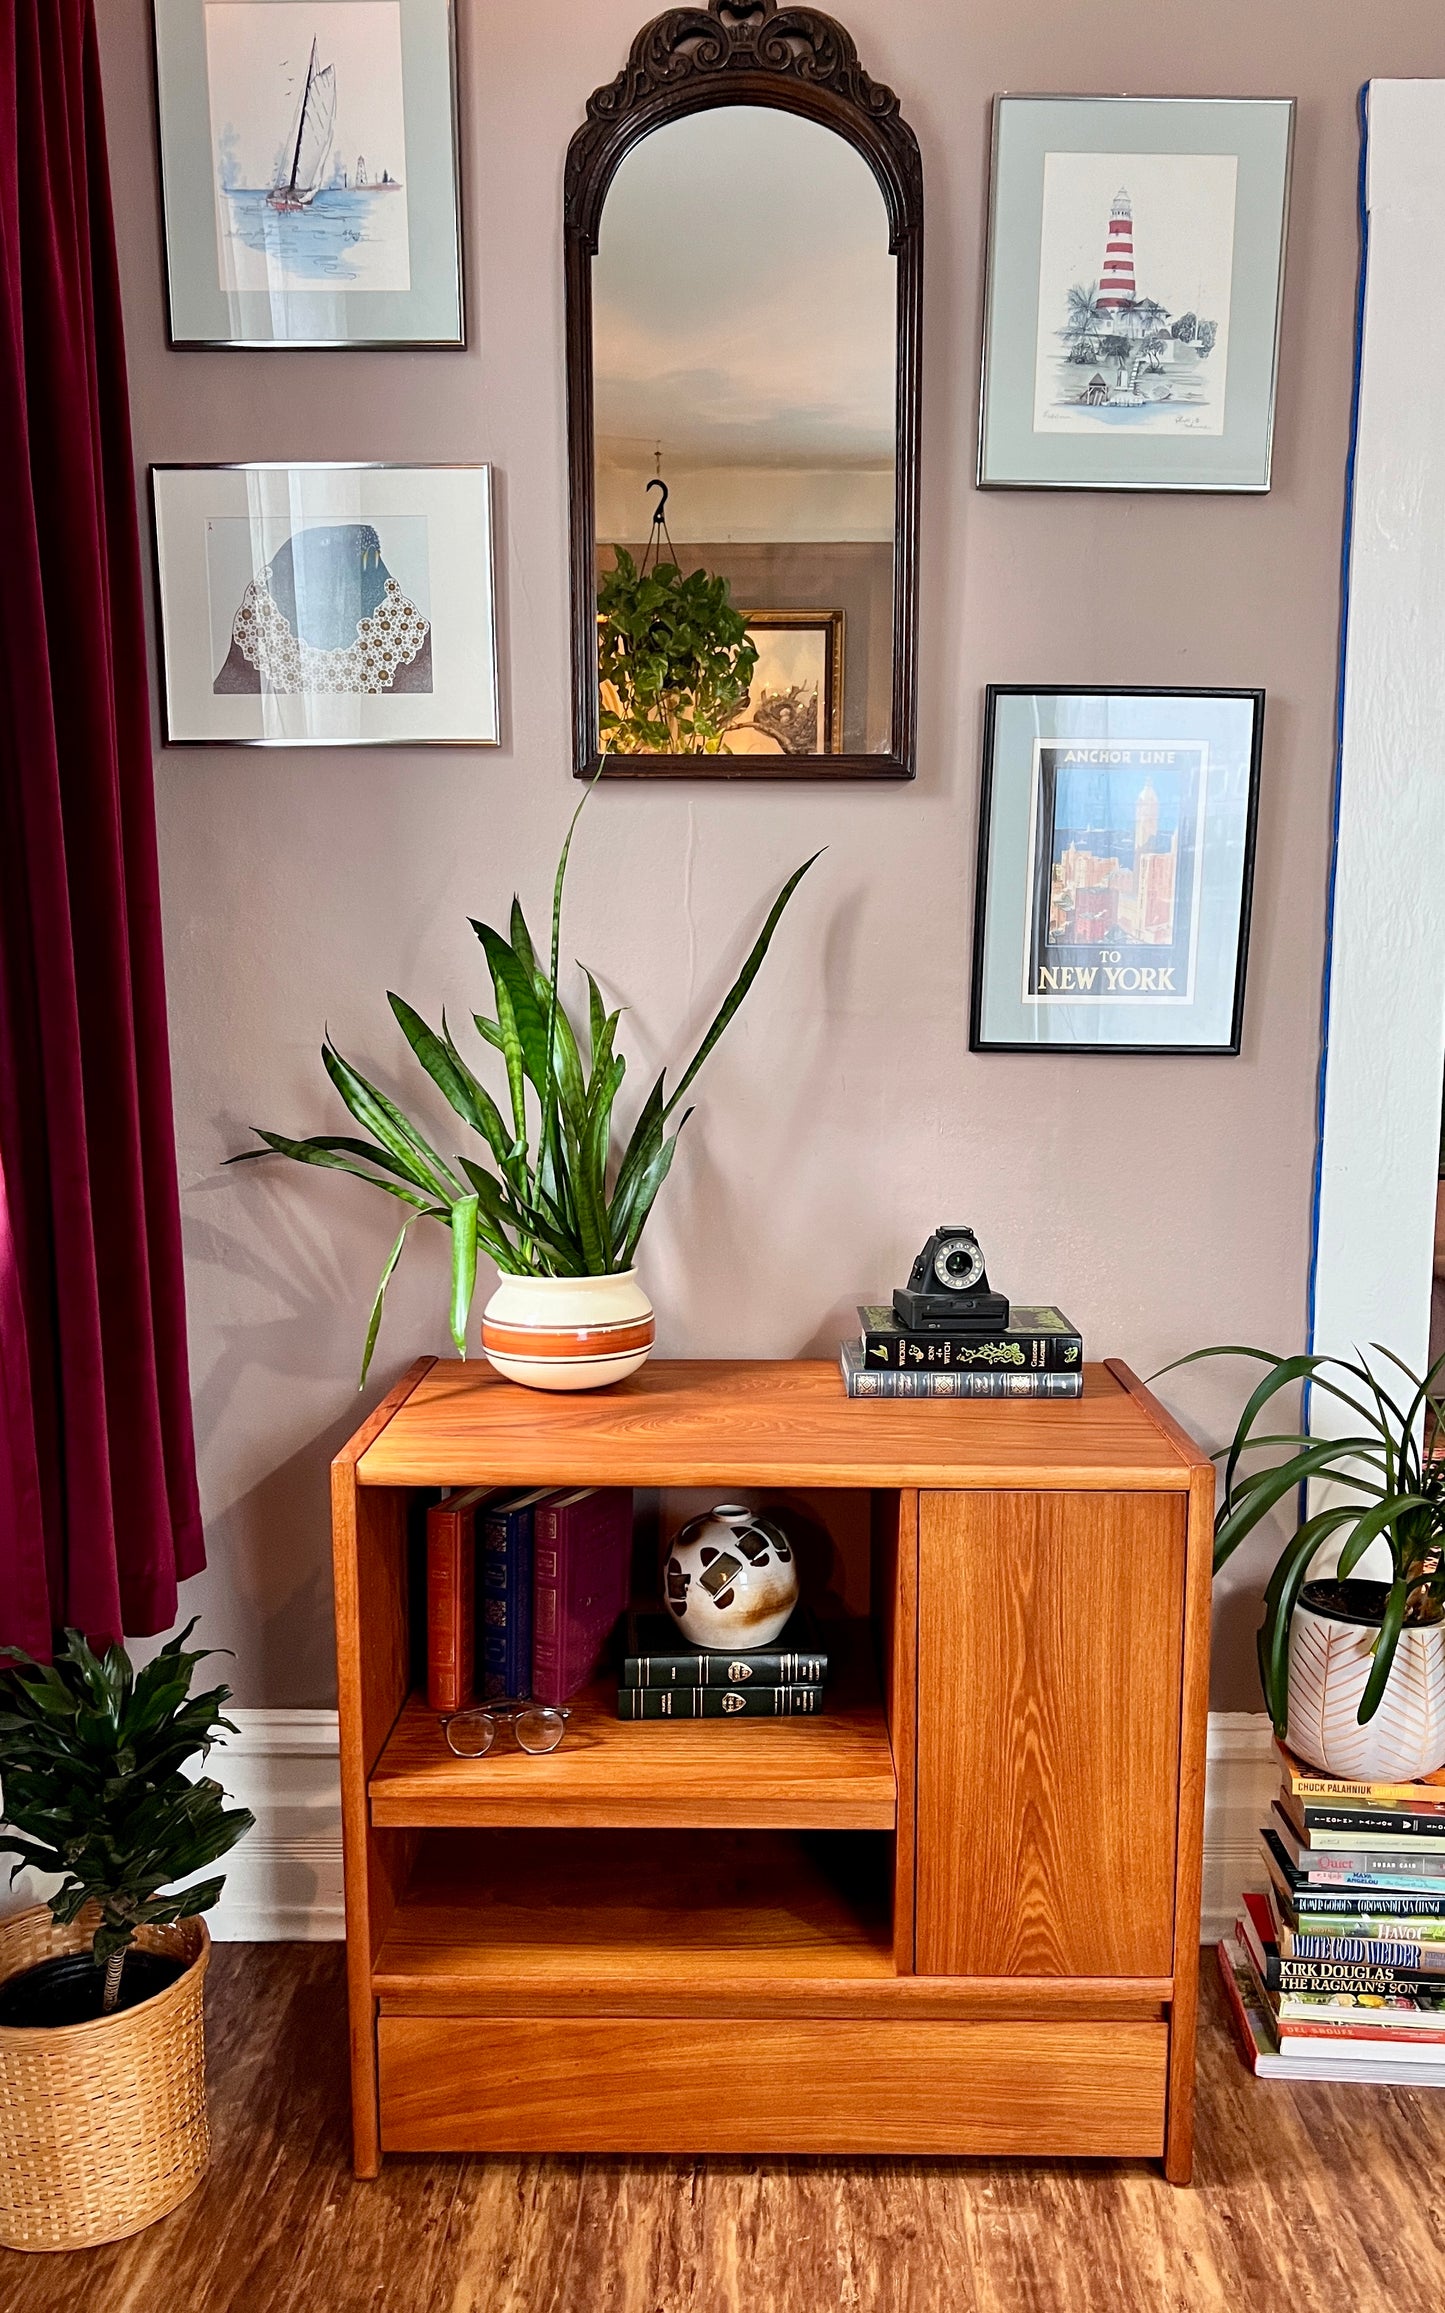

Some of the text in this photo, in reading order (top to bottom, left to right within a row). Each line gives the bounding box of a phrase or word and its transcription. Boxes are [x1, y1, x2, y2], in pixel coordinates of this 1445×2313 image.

[1064, 750, 1176, 764] ANCHOR LINE
[1099, 950, 1121, 962] TO
[1038, 966, 1176, 990] NEW YORK
[1298, 1782, 1325, 1793] CHUCK
[1327, 1783, 1372, 1794] PALAHNIUK
[1359, 1819, 1393, 1827] TAYLOR
[1317, 1856, 1354, 1869] Quiet
[1346, 1877, 1379, 1885] ANGELOU
[1291, 1933, 1332, 1959] WHITE
[1332, 1937, 1366, 1962] GOLD
[1366, 1940, 1422, 1969] WIELDER
[1280, 1961, 1394, 1980] KIRK DOUGLAS
[1280, 1977, 1308, 1990] THE
[1310, 1978, 1386, 1992] RAGMAN'S
[1388, 1982, 1419, 1994] SON
